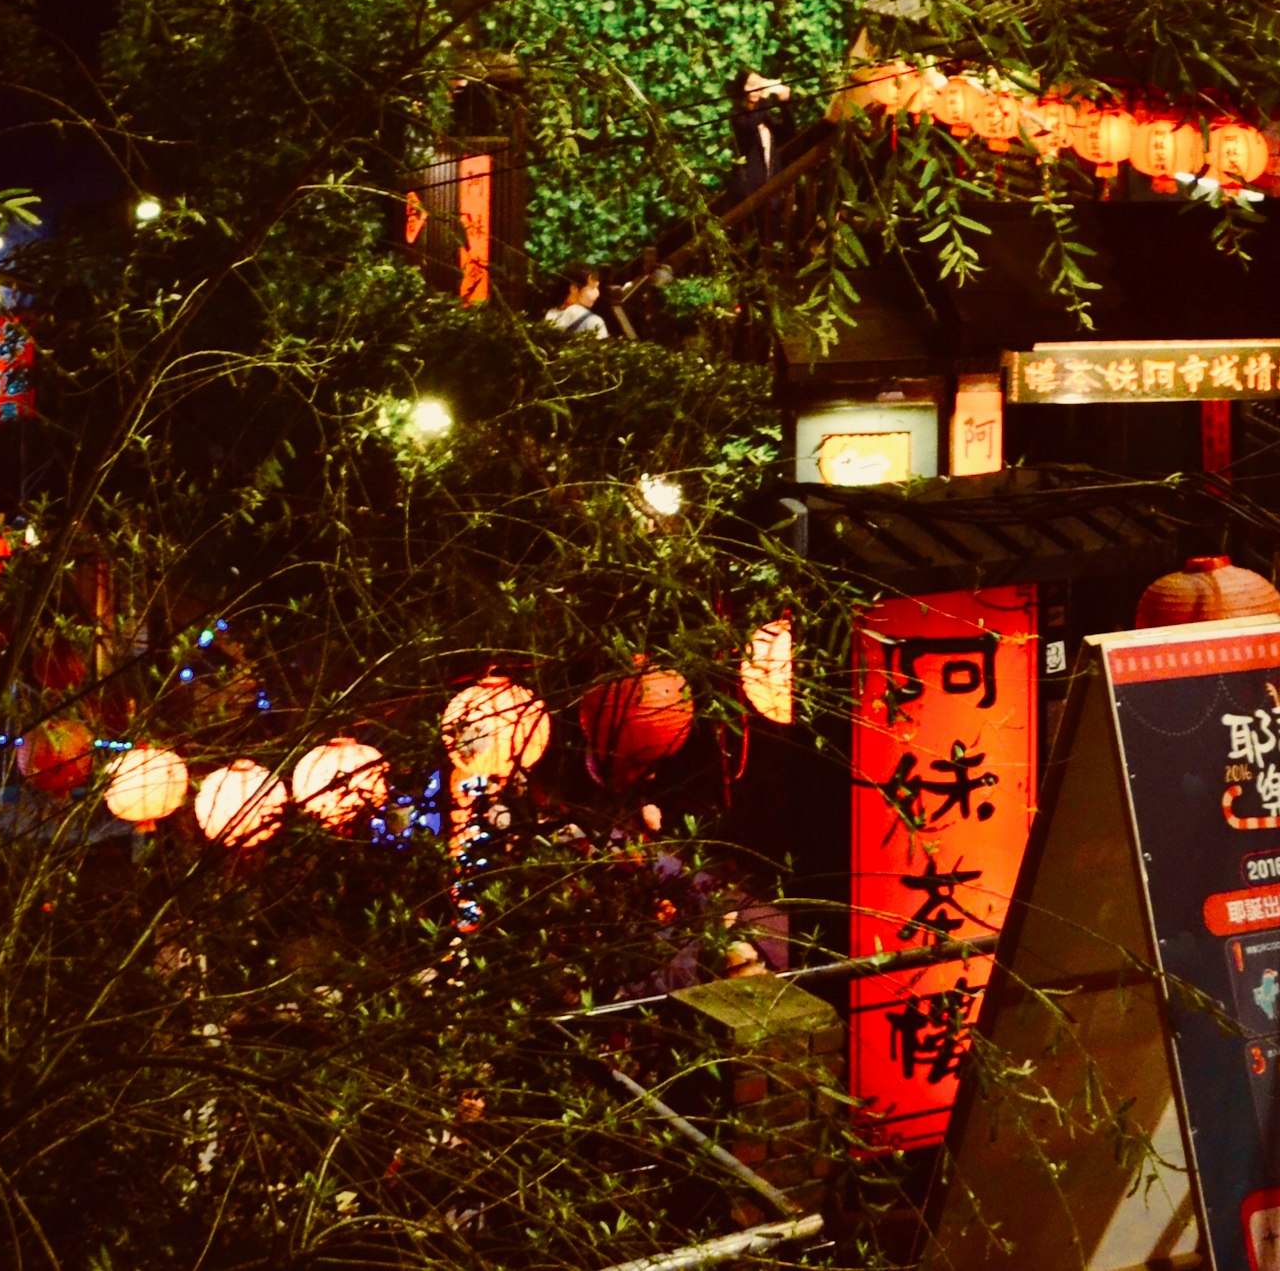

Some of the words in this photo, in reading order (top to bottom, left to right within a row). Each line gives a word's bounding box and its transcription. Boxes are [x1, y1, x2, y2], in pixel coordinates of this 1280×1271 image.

[1225, 765, 1252, 783] 2016
[1232, 941, 1245, 973] 1
[1250, 1045, 1266, 1075] 3
